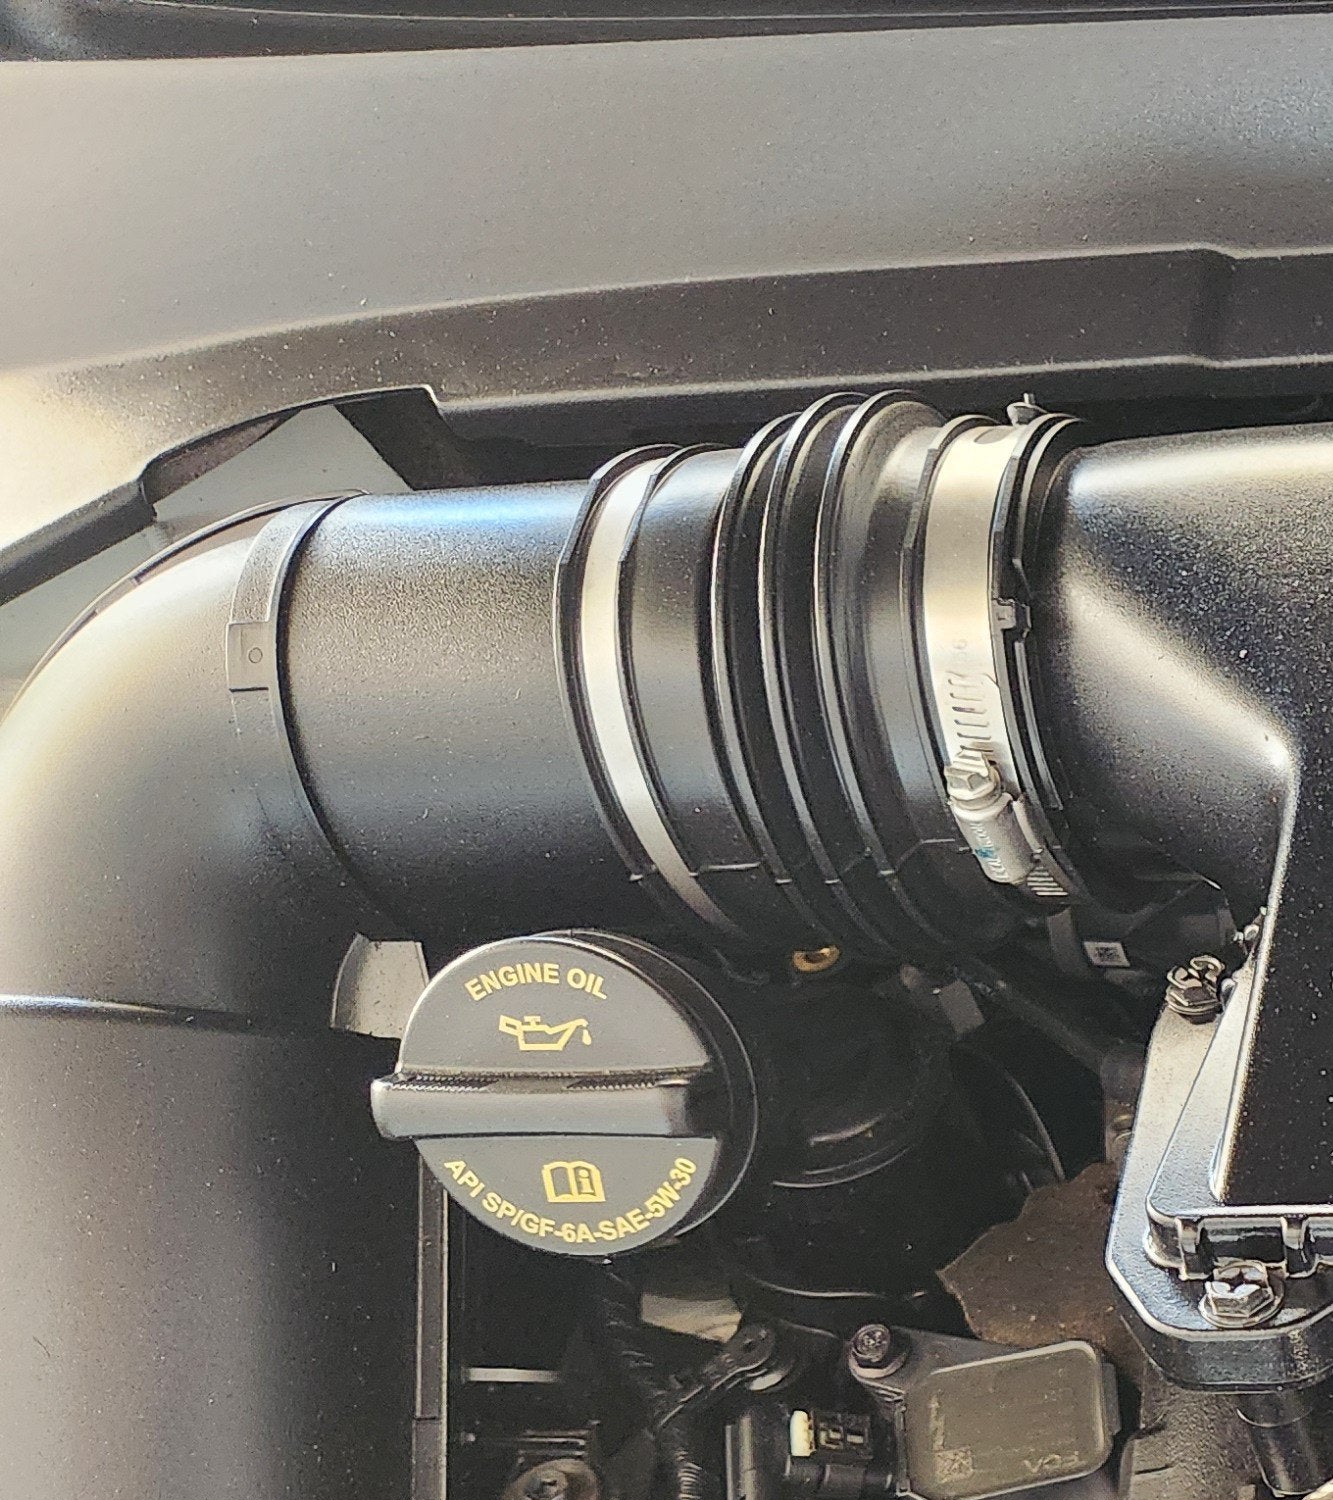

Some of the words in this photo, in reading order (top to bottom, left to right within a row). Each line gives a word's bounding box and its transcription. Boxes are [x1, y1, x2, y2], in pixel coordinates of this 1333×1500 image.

[464, 962, 560, 1001] ENGINE
[567, 968, 607, 999] OIL
[443, 1160, 485, 1198] API
[482, 1157, 697, 1243] SP/GF-6A-SAE-5W-30
